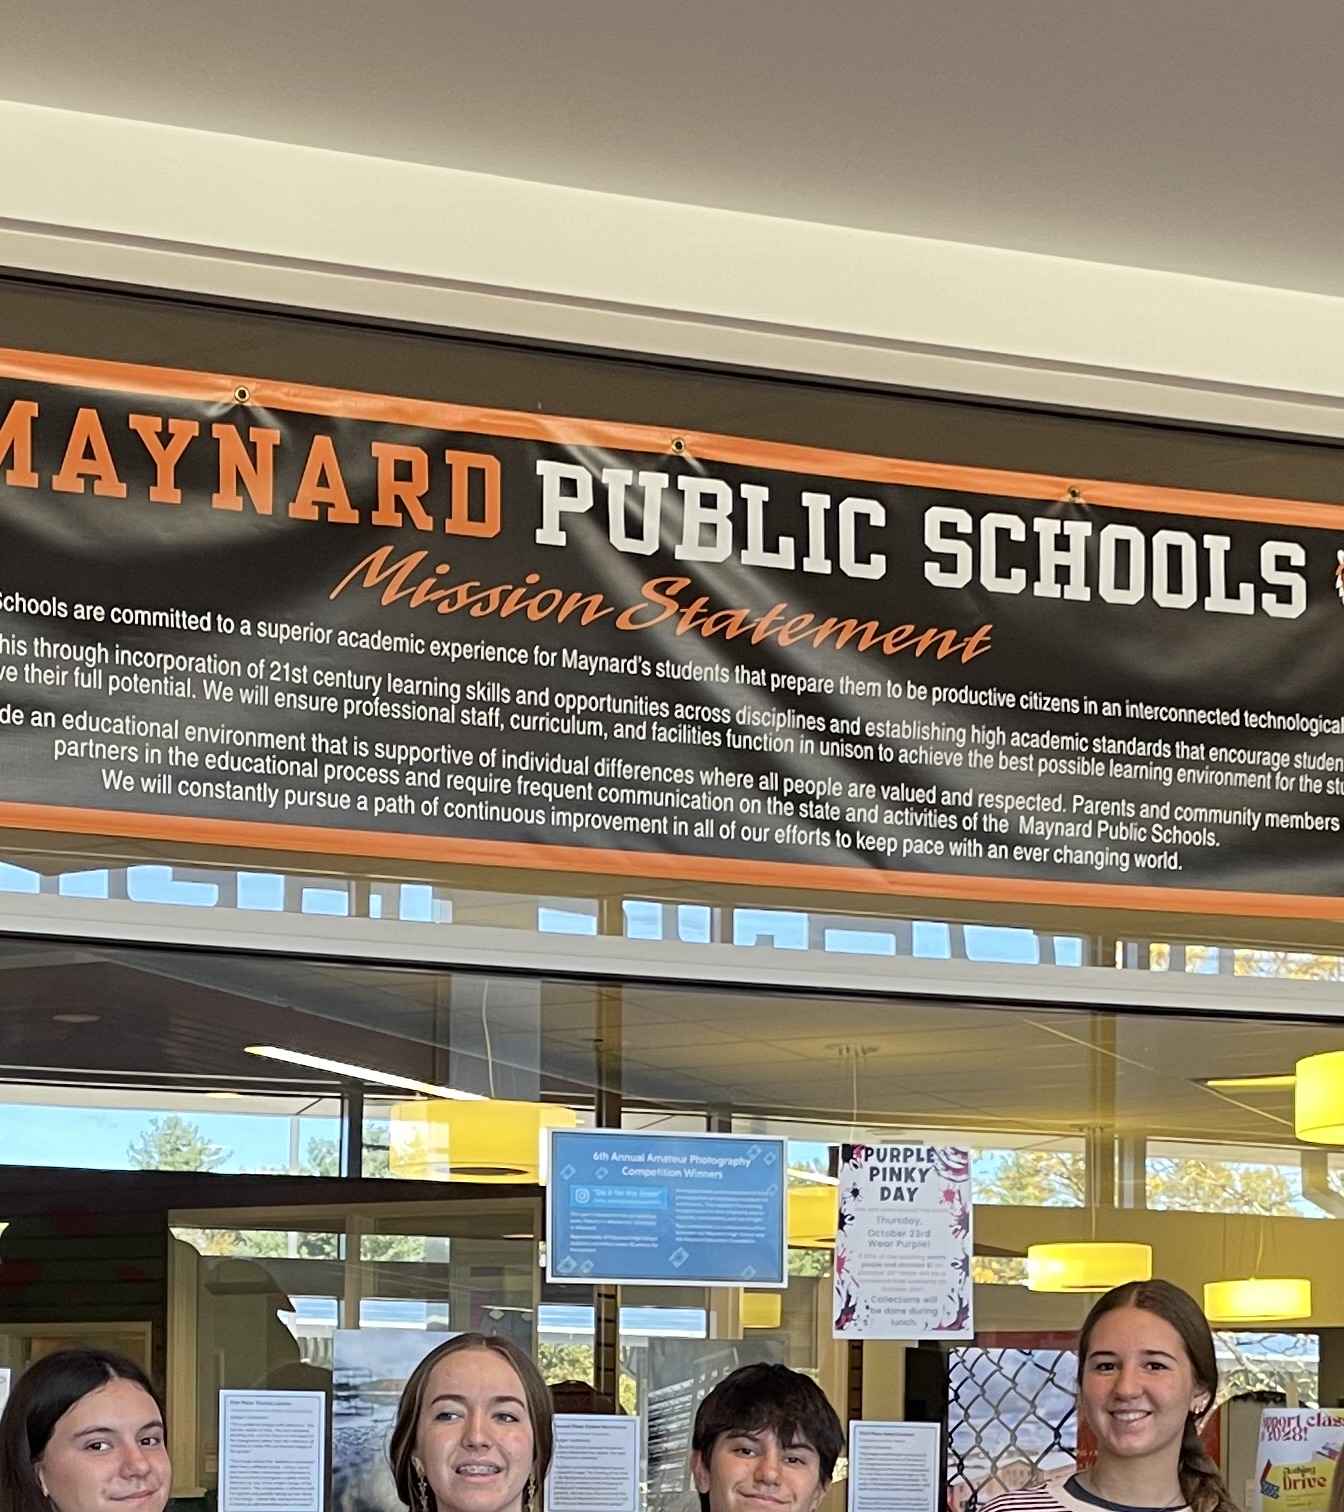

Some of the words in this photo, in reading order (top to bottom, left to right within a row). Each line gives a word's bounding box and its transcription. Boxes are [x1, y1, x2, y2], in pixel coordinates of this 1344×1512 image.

[534, 458, 887, 580] PUBLIC
[923, 504, 1308, 619] SCHOOLS
[329, 545, 615, 626] Mission
[614, 575, 994, 664] Statement
[73, 604, 104, 620] are
[110, 607, 210, 631] committed
[216, 613, 234, 633] to
[240, 621, 251, 635] a
[256, 622, 332, 644] superior
[337, 628, 424, 652] academic
[429, 639, 528, 663] experience
[533, 645, 557, 666] for
[562, 648, 651, 674] Maynard's
[655, 657, 728, 681] students
[734, 664, 766, 685] that
[770, 672, 833, 693] prepare
[840, 673, 880, 695] them
[886, 677, 902, 697] to
[906, 679, 926, 699] be
[932, 684, 1015, 707] productive
[1019, 690, 1079, 712] citizens
[1083, 694, 1097, 713] in
[1101, 701, 1121, 715] an
[1125, 698, 1240, 725] interconnected
[1243, 708, 1344, 736] technological
[33, 636, 108, 666] through
[115, 644, 240, 676] incorporation
[246, 659, 264, 679] of
[270, 660, 307, 683] 21st
[313, 668, 382, 695] century
[387, 672, 460, 702] learning
[465, 681, 510, 703] skills
[515, 687, 548, 706] and
[554, 693, 669, 717] opportunities
[674, 704, 730, 722] across
[735, 705, 825, 732] disciplines
[829, 715, 860, 733] and
[865, 717, 966, 747] establishing
[971, 725, 1005, 749] high
[1010, 730, 1088, 752] academic
[1092, 735, 1171, 758] standards
[1174, 741, 1204, 761] that
[1208, 748, 1290, 771] encourage
[30, 711, 55, 727] an
[62, 710, 178, 739] educational
[184, 724, 305, 751] environment
[311, 732, 347, 754] that
[353, 736, 368, 756] is
[374, 743, 473, 765] supportive
[478, 748, 496, 767] of
[502, 749, 588, 775] individual
[594, 757, 694, 783] differences
[699, 767, 753, 788] where
[758, 771, 778, 790] all
[783, 775, 842, 798] people
[847, 782, 875, 797] are
[880, 781, 936, 802] valued
[940, 786, 972, 805] and
[978, 791, 1066, 812] respected.
[1072, 794, 1135, 816] Parents
[1139, 800, 1170, 819] and
[1174, 806, 1261, 829] community
[1264, 810, 1340, 830] members
[102, 766, 134, 788] We
[140, 772, 171, 793] will
[178, 779, 278, 808] constantly
[284, 791, 350, 810] pursue
[356, 797, 368, 811] a
[374, 795, 414, 818] path
[420, 798, 437, 817] of
[443, 802, 545, 826] continuous
[551, 807, 668, 835] improvement
[673, 816, 688, 836] in
[693, 818, 713, 838] all
[719, 820, 735, 839] of
[740, 826, 769, 842] our
[774, 824, 830, 846] efforts
[835, 828, 851, 847] to
[856, 829, 897, 855] keep
[902, 838, 944, 856] pace
[948, 837, 982, 856] with
[987, 844, 1008, 858] an
[1012, 845, 1049, 861] ever
[1053, 844, 1129, 870] changing
[1133, 850, 1182, 869] world.
[592, 1151, 609, 1161] 6th
[610, 1151, 645, 1163] Annual
[646, 1153, 687, 1164] Amateur
[689, 1154, 752, 1168] Photography
[864, 1147, 935, 1163] PURPLE
[621, 1166, 682, 1179] Competition
[683, 1167, 723, 1180] Winners
[869, 1166, 931, 1183] PINKY
[880, 1186, 919, 1202] DAY
[867, 1229, 906, 1238] October
[909, 1229, 931, 1238] 23rd
[868, 1240, 894, 1248] Wear
[909, 1306, 938, 1317] during
[1283, 1473, 1327, 1491] Drive
